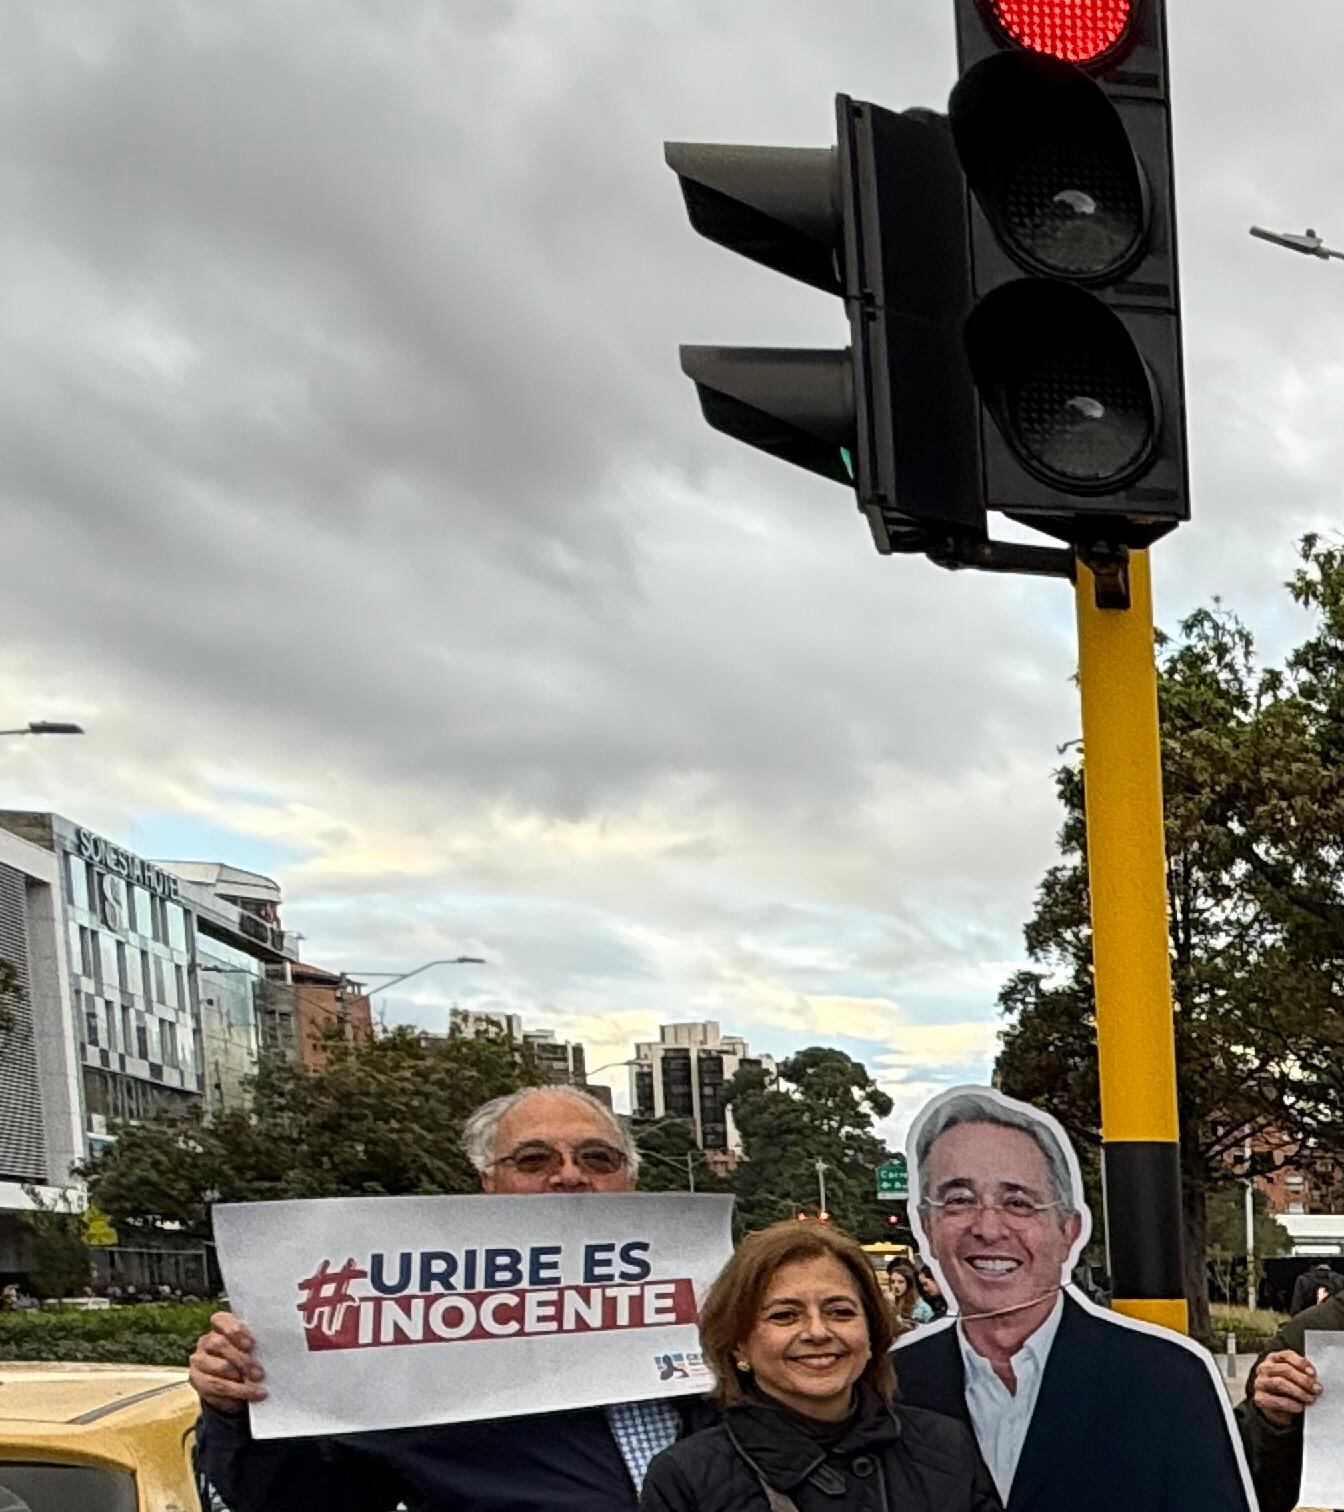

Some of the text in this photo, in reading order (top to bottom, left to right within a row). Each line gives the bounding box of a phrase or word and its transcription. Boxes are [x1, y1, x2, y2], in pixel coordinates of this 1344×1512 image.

[297, 1241, 652, 1328] #URIBE ES
[357, 1284, 676, 1344] INOCENTE
